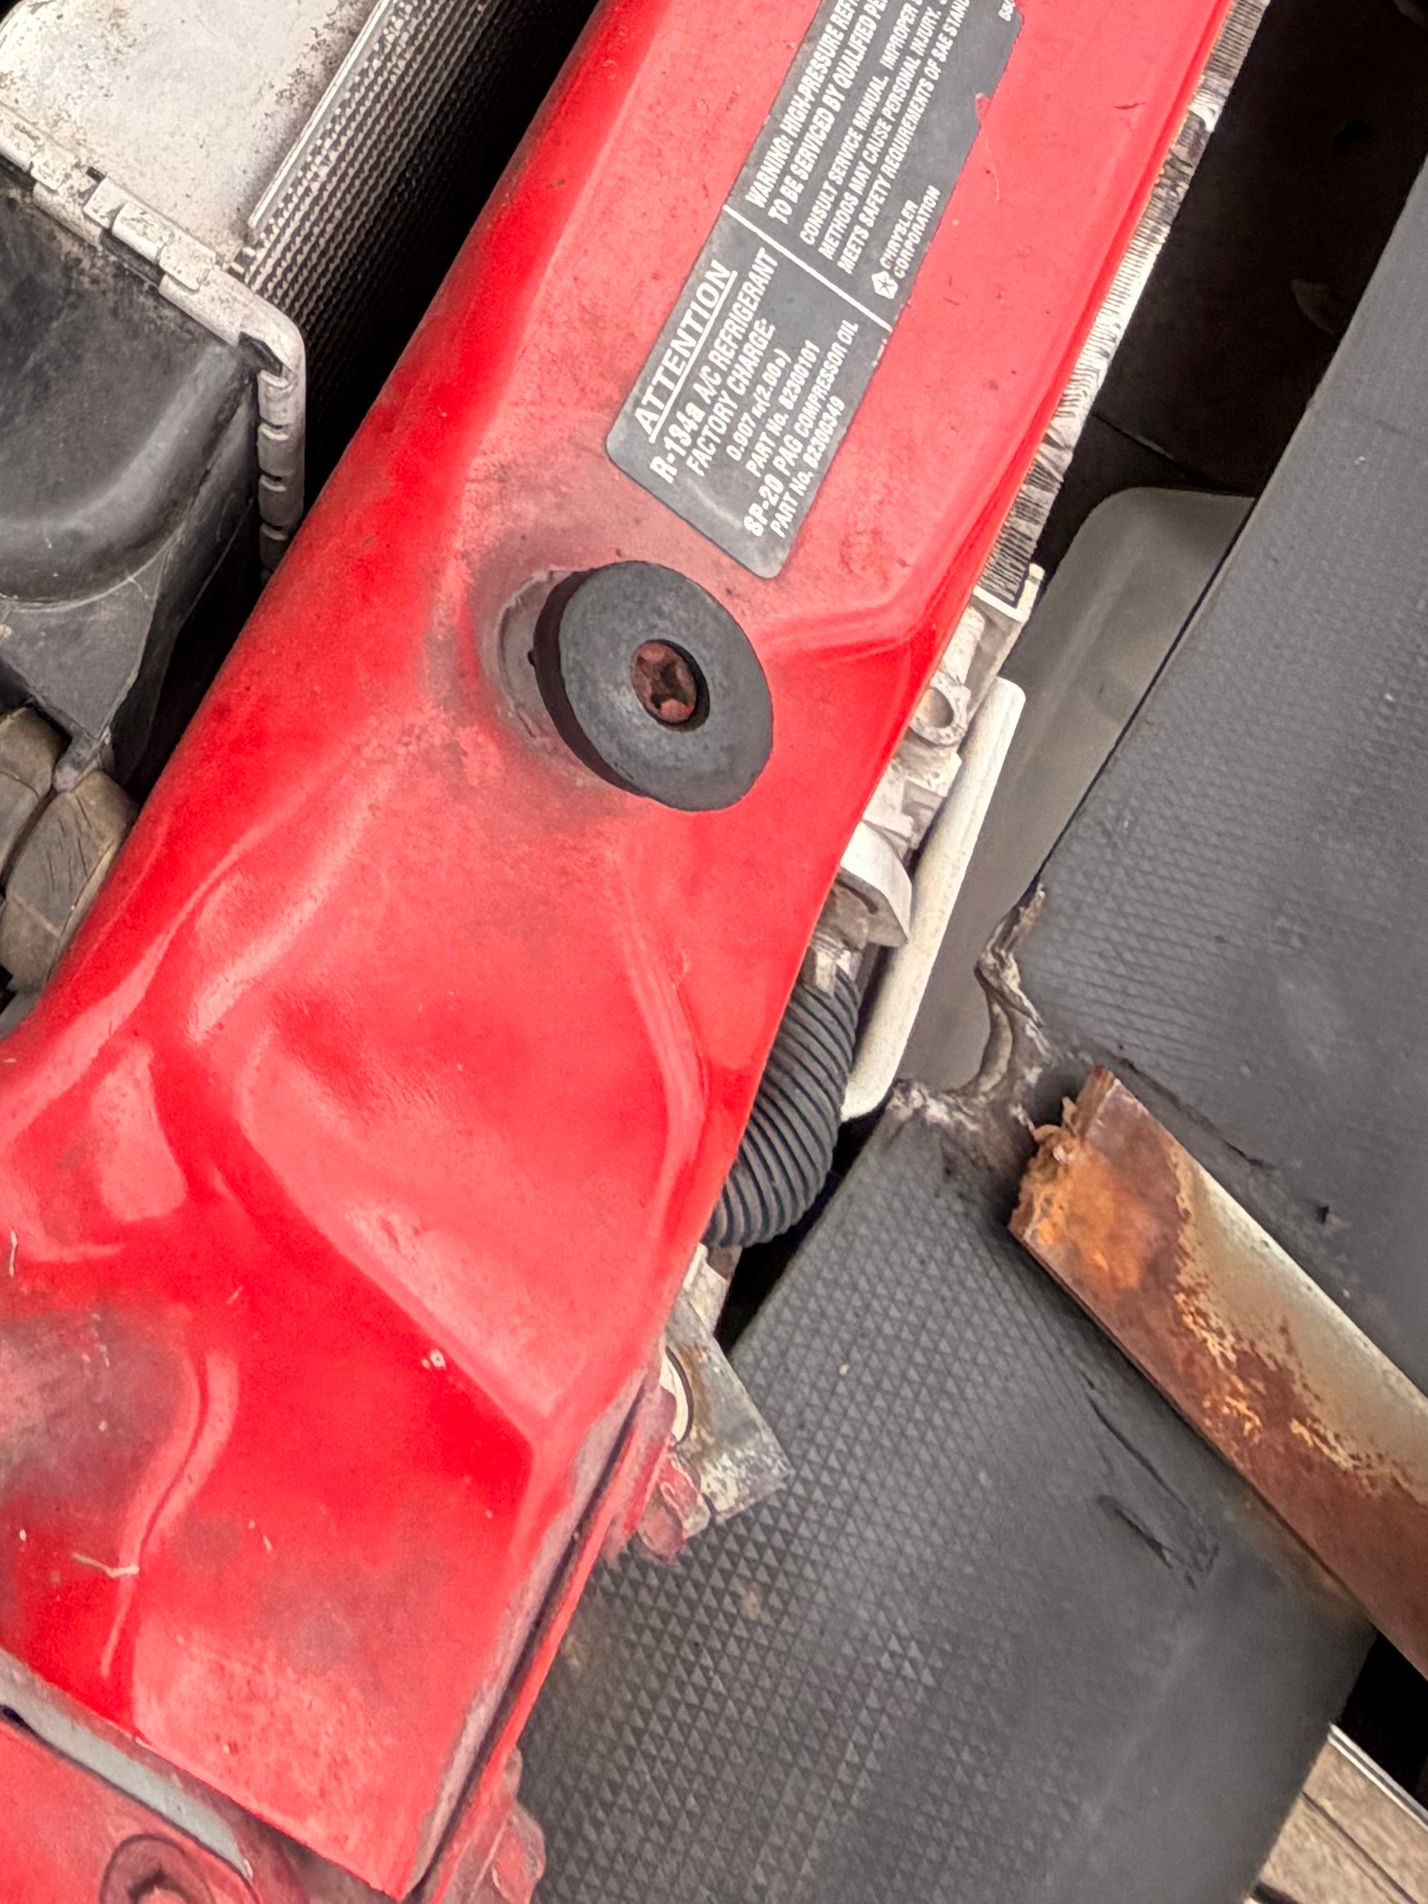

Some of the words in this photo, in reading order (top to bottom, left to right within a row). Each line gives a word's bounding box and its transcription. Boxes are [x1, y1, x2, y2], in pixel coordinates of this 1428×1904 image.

[832, 14, 877, 89] QUALIFIED
[924, 58, 942, 80] OF
[931, 33, 954, 62] SAE
[745, 134, 794, 208] WARNING:
[780, 24, 844, 138] HIGH-PRESSURE
[800, 180, 838, 245] CONSULT
[828, 127, 864, 185] SERVICE
[852, 76, 890, 131] MANUAL.
[879, 2, 919, 71] IMPROPER
[818, 192, 859, 260] METHODS
[848, 160, 872, 196] MAY
[862, 118, 892, 164] CAUSE
[882, 56, 922, 122] PERSONAL
[910, 6, 942, 56] INJURY.
[822, 83, 846, 112] BY
[880, 78, 934, 179] REQUIREMENTS
[790, 107, 835, 180] SERVICED
[768, 198, 793, 224] TO
[780, 175, 804, 203] BE
[858, 174, 891, 228] SAFETY
[837, 225, 870, 274] MEETS
[880, 200, 918, 270] CHRYSLER
[894, 185, 940, 279] CORPORATION
[634, 259, 731, 437] ATTENTION
[650, 402, 706, 484] R-134a
[692, 365, 722, 404] A/C
[708, 247, 778, 372] REFRIGERANT
[686, 390, 738, 477] FACTORY
[726, 318, 776, 396] CHARGE:
[743, 474, 784, 537] SP-20
[772, 434, 804, 477] PAG
[794, 342, 848, 438] COMPRESSOR
[837, 320, 859, 345] OIL
[745, 431, 776, 478] PART
[765, 412, 790, 437] No.
[770, 491, 798, 538] PART
[789, 471, 814, 496] No.
